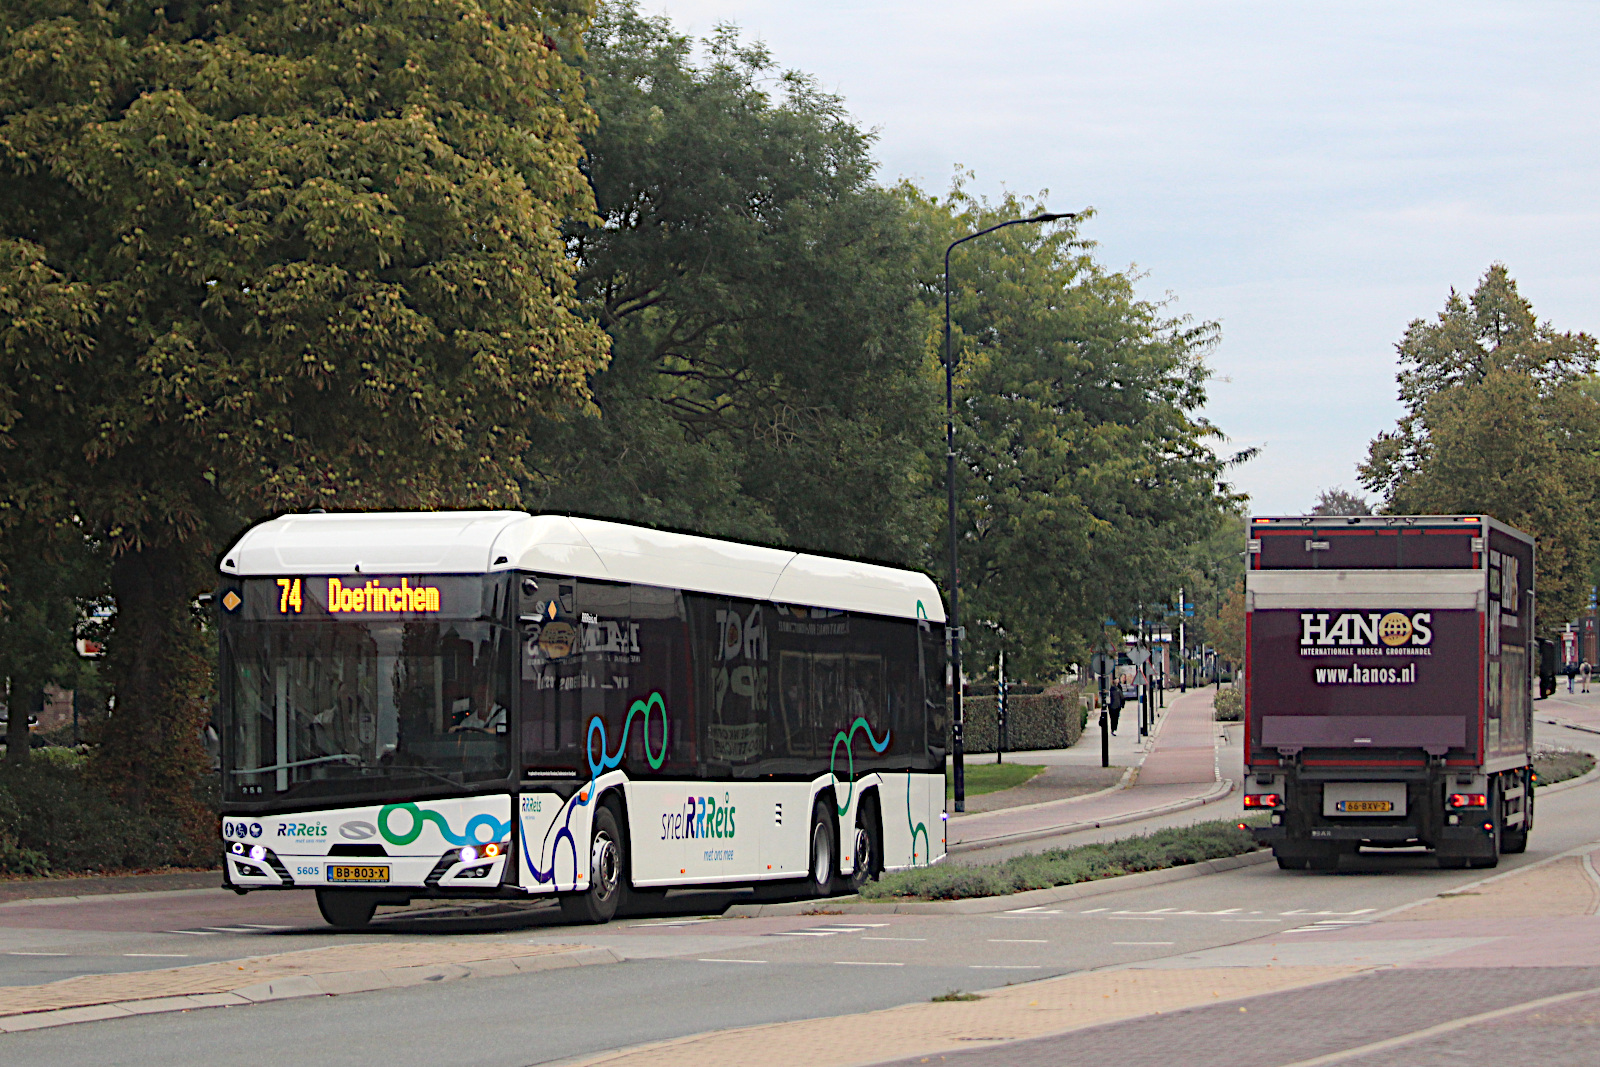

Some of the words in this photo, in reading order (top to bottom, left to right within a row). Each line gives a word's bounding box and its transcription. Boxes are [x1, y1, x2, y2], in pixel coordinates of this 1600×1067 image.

[276, 578, 302, 613] 74
[328, 577, 440, 612] Doetinchem
[1300, 612, 1432, 646] HANOS
[1300, 647, 1354, 656] INTERNATIONALE
[1357, 647, 1383, 656] HORECA
[1386, 647, 1432, 656] GROOTHANDEL
[1315, 662, 1416, 684] www.hanos.nl
[277, 821, 328, 837] RRReis
[297, 866, 319, 875] 5605
[336, 867, 385, 878] BB-803-X
